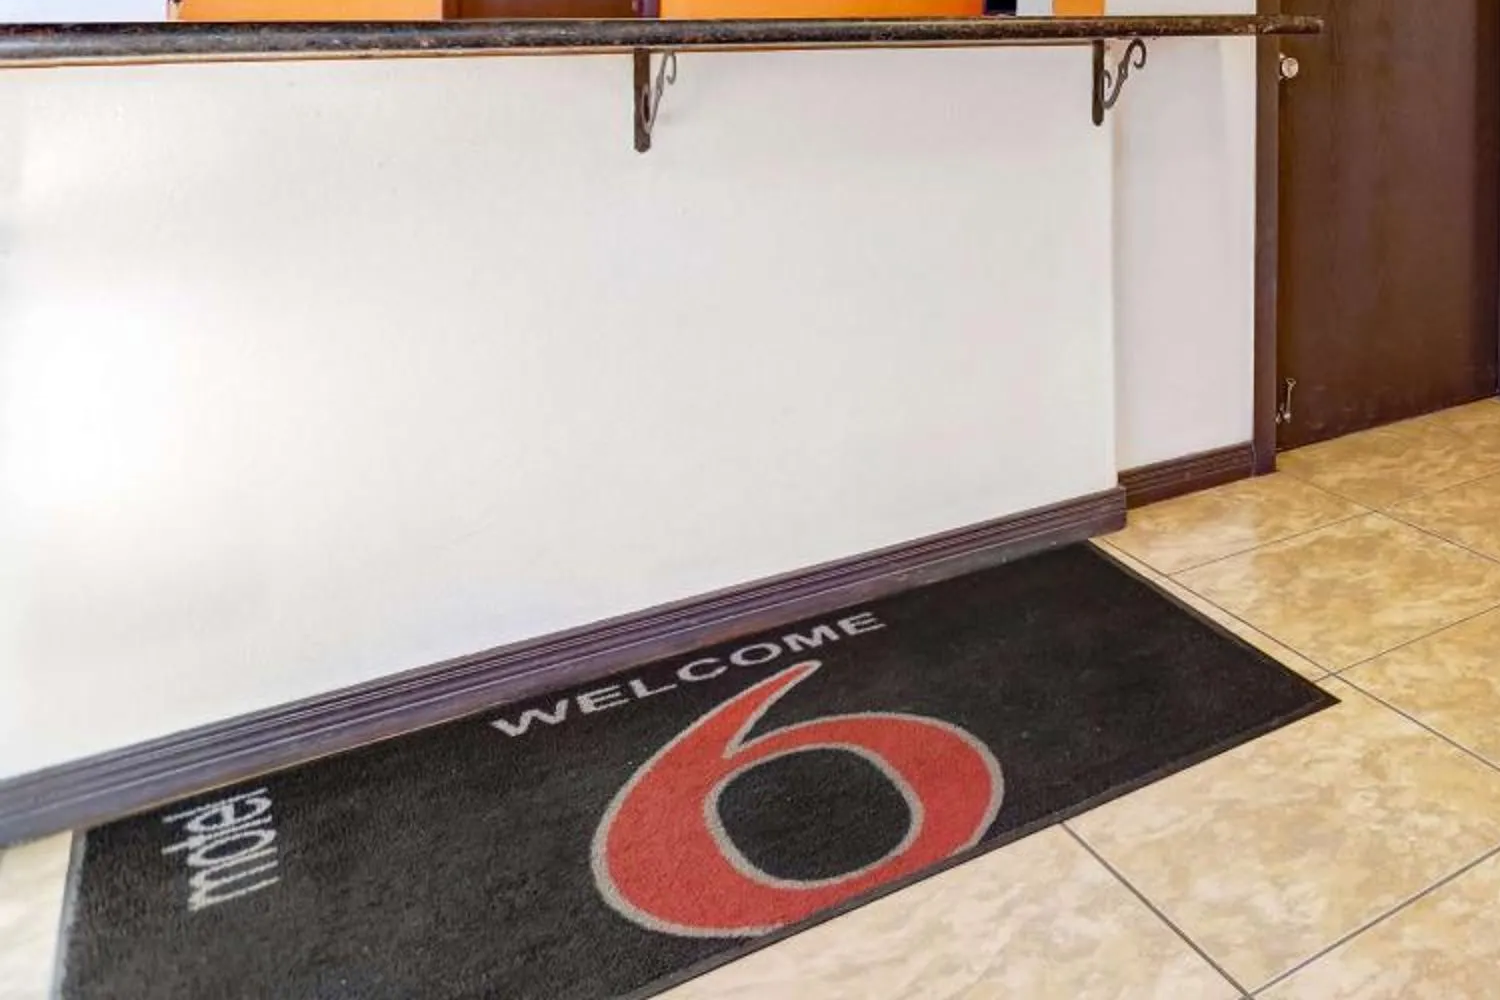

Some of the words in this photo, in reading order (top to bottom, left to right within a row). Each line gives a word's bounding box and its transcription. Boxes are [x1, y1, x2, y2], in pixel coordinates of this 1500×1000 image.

[490, 610, 888, 738] WELCOME
[161, 787, 280, 912] motel
[589, 659, 1006, 938] 6
